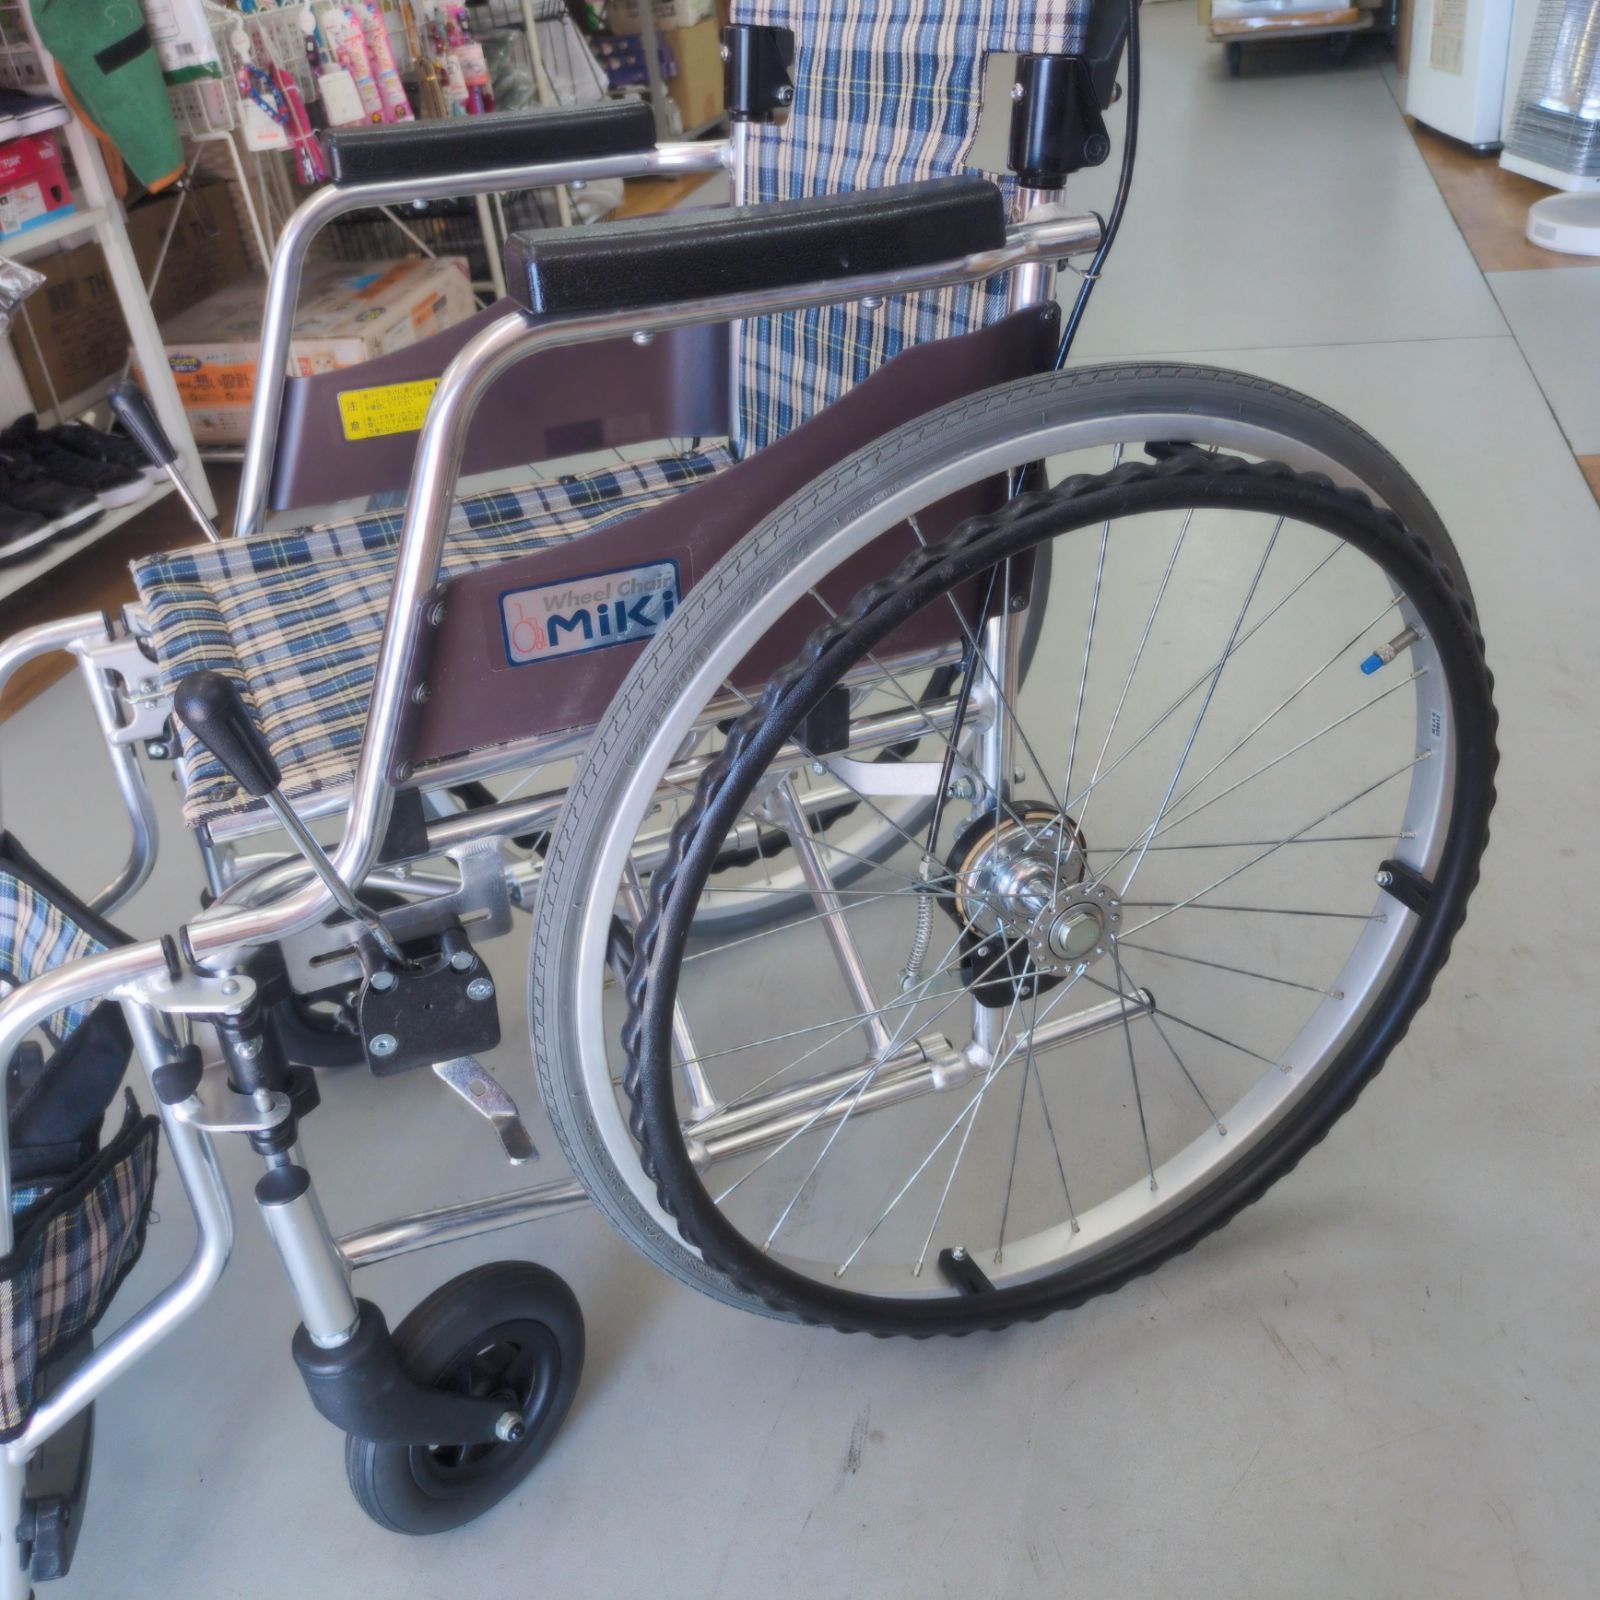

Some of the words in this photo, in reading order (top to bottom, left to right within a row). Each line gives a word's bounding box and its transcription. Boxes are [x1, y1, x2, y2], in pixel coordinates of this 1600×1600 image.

[543, 582, 612, 612] Wheel
[617, 571, 673, 597] Chair
[546, 590, 674, 648] MiKi
